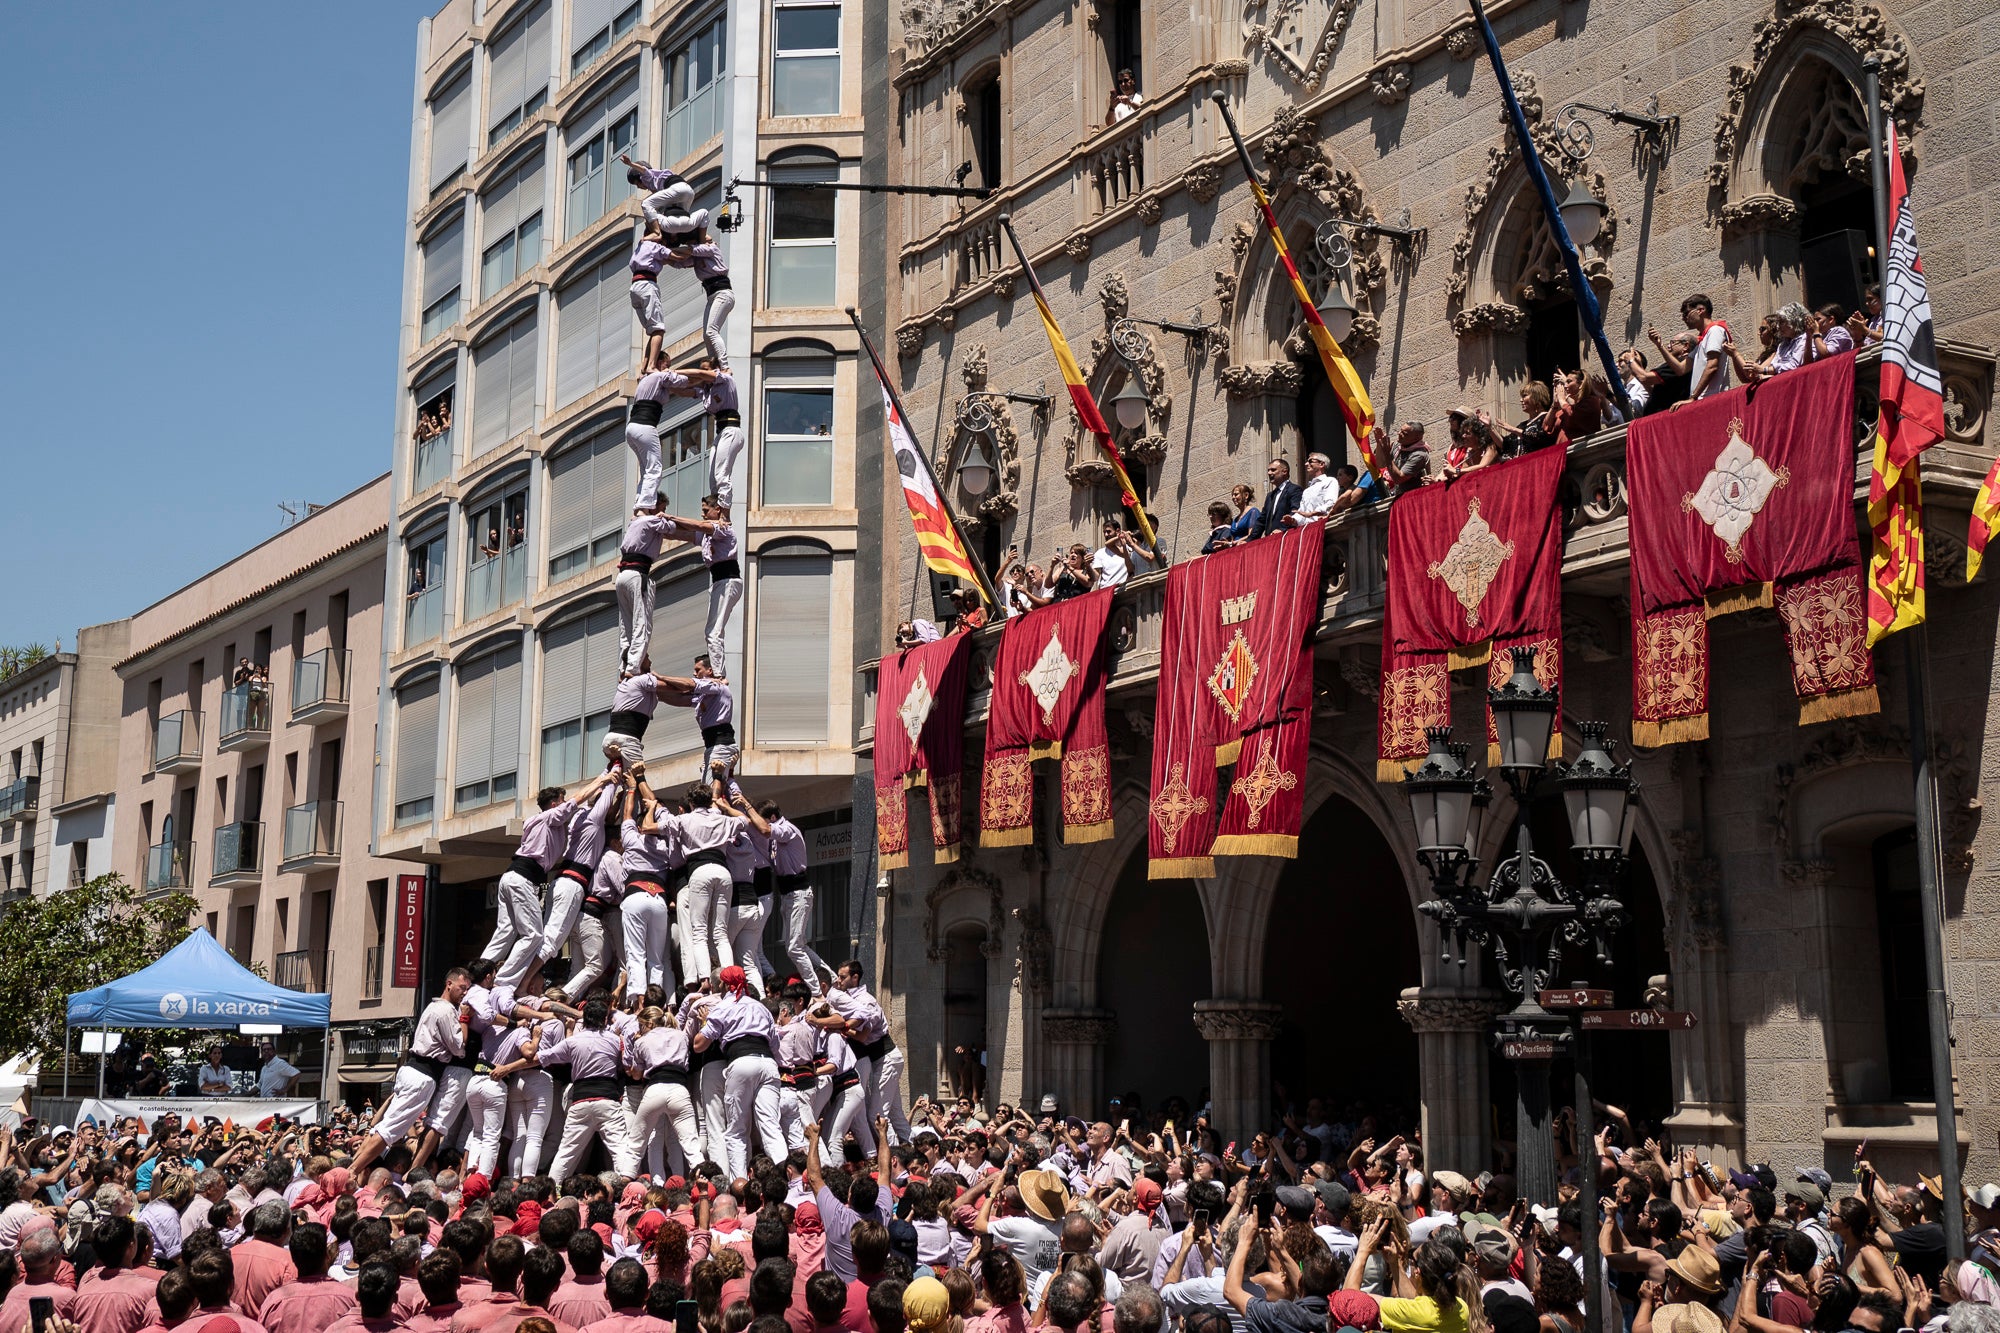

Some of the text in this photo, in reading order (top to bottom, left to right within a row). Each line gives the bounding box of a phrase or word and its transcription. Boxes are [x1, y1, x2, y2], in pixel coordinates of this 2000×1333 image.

[816, 829, 852, 847] Advocats
[404, 880, 418, 965] MEDICAL
[192, 998, 210, 1014] la
